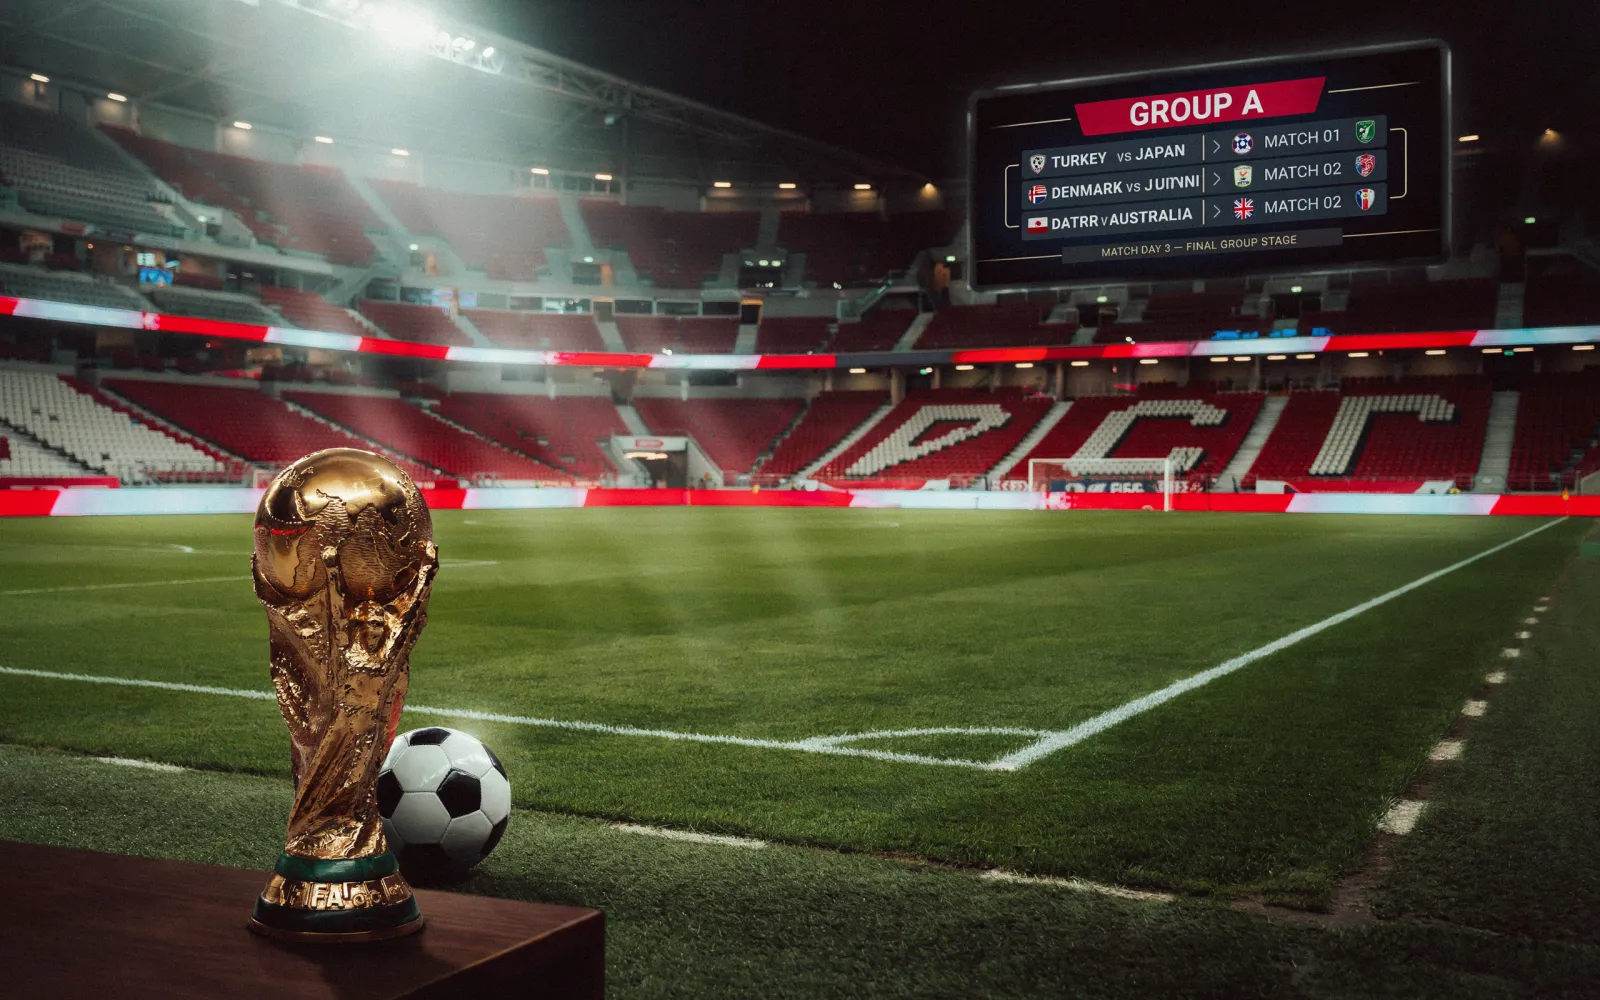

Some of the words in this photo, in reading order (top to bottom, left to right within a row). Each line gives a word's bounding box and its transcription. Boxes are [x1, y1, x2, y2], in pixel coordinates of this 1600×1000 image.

[1129, 93, 1233, 126] GROUP
[1241, 89, 1264, 115] A
[1264, 131, 1319, 148] MATCH
[1323, 129, 1340, 142] 01
[1051, 151, 1107, 168] TURKEY
[1135, 144, 1185, 161] JAPAN
[1264, 164, 1319, 181] MATCH
[1323, 162, 1342, 176] 02
[1051, 181, 1123, 199] DENMARK
[1264, 197, 1319, 214] MATCH
[1323, 195, 1342, 209] 02
[1051, 214, 1099, 230] DATRR
[1108, 207, 1193, 226] AUSTRALIA
[1101, 246, 1138, 257] MATCH
[1141, 244, 1162, 255] DAY
[1164, 243, 1171, 253] 3
[1186, 241, 1217, 251] FINAL
[1220, 238, 1258, 249] GROUP
[1261, 235, 1297, 246] STAGE
